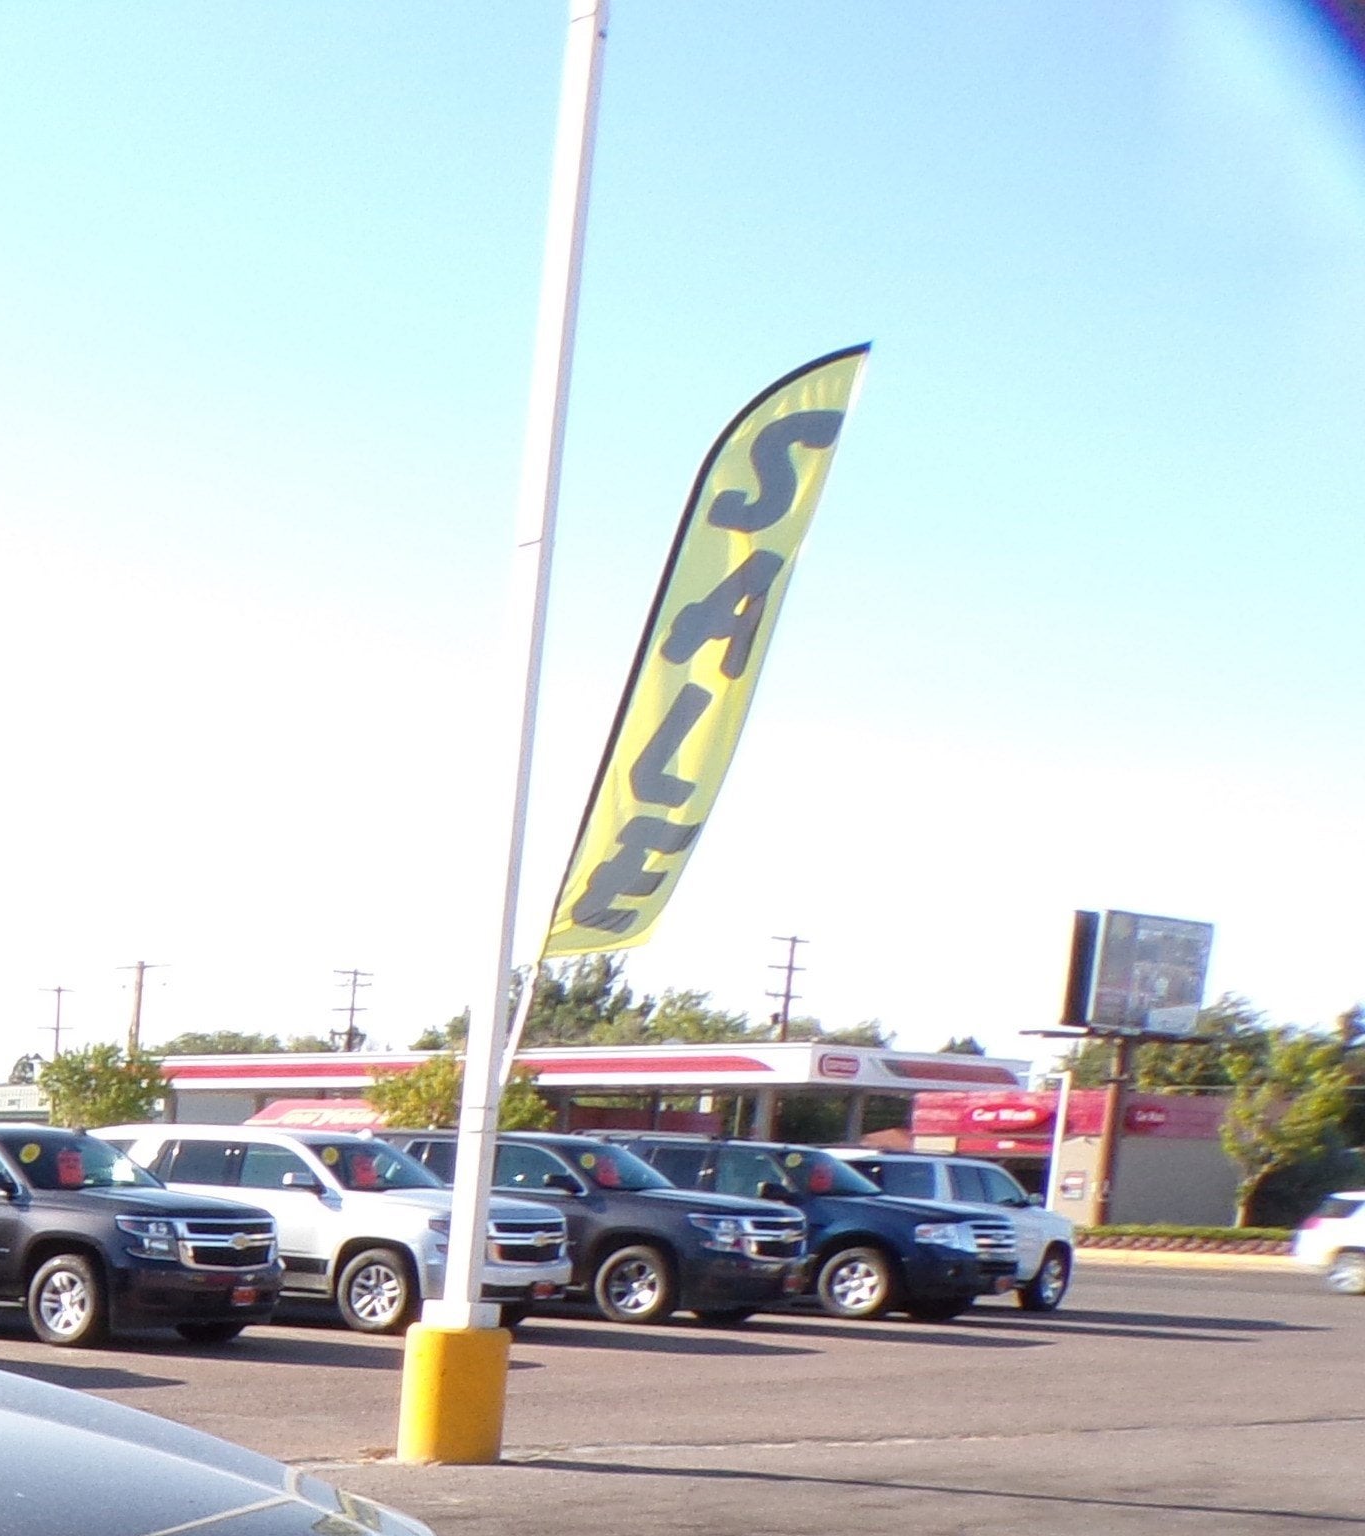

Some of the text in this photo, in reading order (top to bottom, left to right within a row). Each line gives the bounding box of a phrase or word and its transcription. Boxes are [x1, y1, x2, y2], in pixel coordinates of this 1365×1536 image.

[571, 409, 845, 935] SALE
[972, 1108, 1037, 1122] Car Wash
